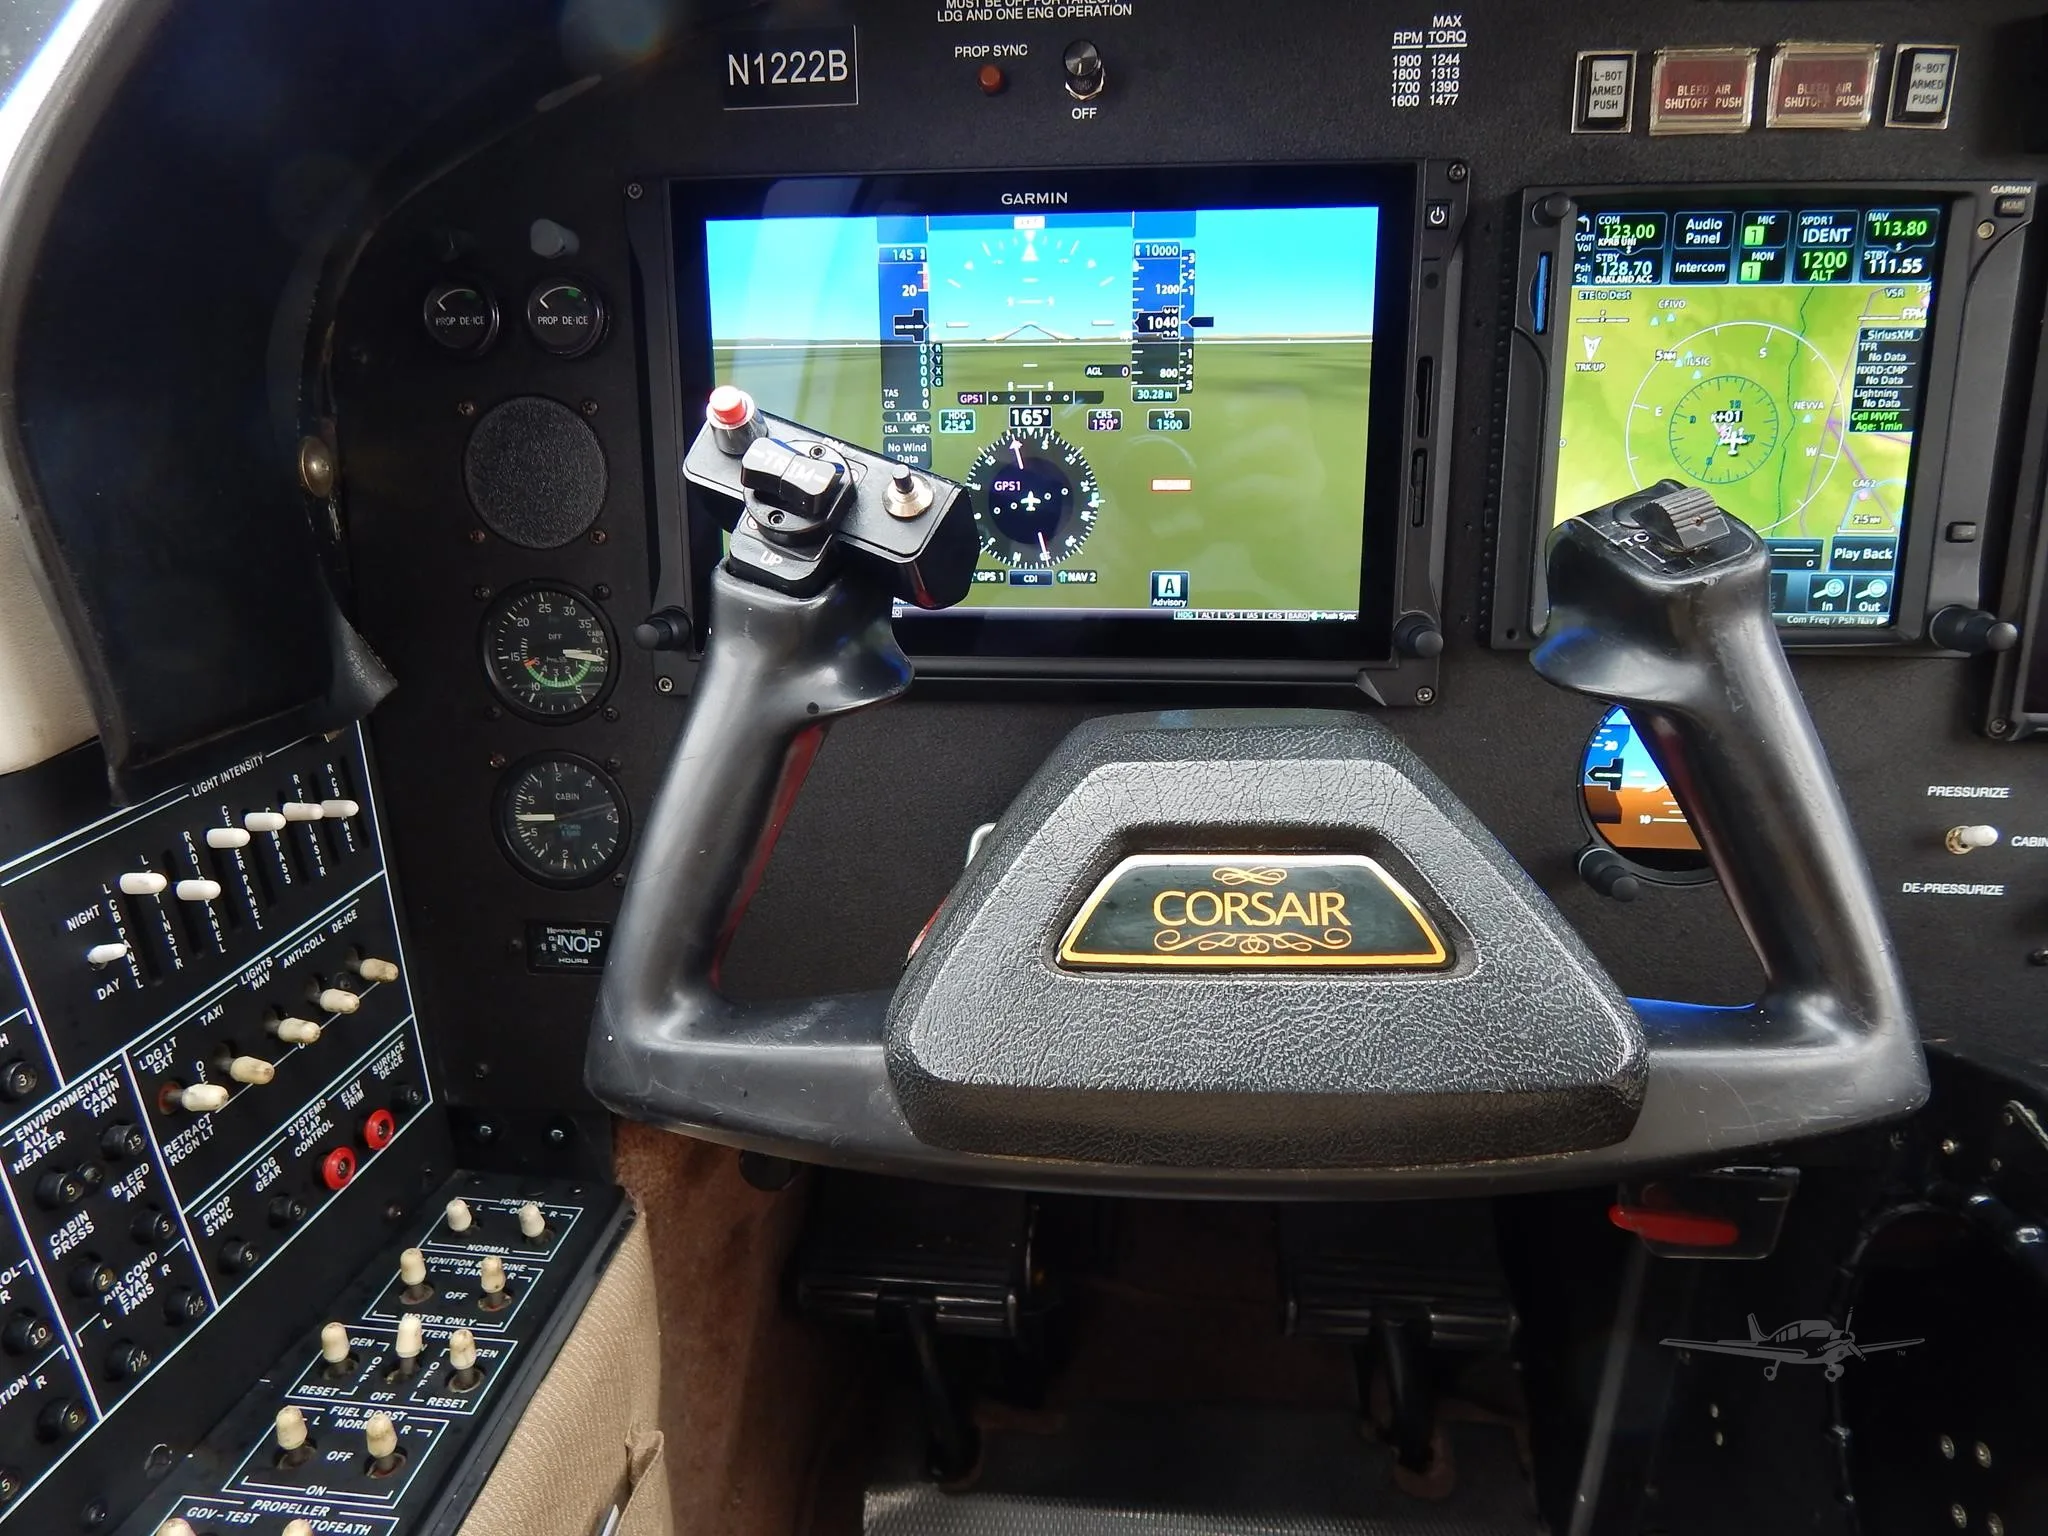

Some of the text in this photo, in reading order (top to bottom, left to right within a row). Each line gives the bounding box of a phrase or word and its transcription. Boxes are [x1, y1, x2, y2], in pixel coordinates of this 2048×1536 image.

[938, 4, 1132, 22] LDG AND ONE ENG OPERATION
[1432, 15, 1463, 28] MAX
[1393, 30, 1467, 45] RPM TORQ
[954, 43, 1029, 58] PROP SYNC
[1392, 53, 1461, 67] 1900 1244
[728, 48, 849, 87] N1222B
[1391, 67, 1460, 80] 1800 1313
[1914, 62, 1946, 74] R-BOT
[1593, 71, 1623, 81] L-BOT
[1391, 80, 1459, 94] 1700 1390
[1592, 85, 1623, 96] ARMED
[1714, 84, 1731, 95] AIR
[1911, 79, 1944, 90] ARMED
[1391, 93, 1459, 107] 1600 1477
[1593, 99, 1618, 110] PUSH
[1664, 96, 1743, 110] SHUTOFF PUSH
[1835, 94, 1864, 107] PUSH
[1911, 93, 1939, 104] PUSH
[1072, 107, 1098, 120] OFF
[1990, 185, 2032, 194] GARMIN
[1001, 191, 1068, 205] GARMIN
[1599, 215, 1620, 226] COM
[1757, 215, 1775, 225] MIC
[1801, 214, 1833, 226] XPDR1
[1868, 211, 1888, 222] NAV
[1685, 217, 1723, 231] Audio
[1872, 220, 1927, 237] 113.80
[1575, 232, 1596, 242] Com
[1604, 224, 1656, 240] 123.00
[1802, 227, 1851, 244] IDENT
[1685, 232, 1720, 247] Panel
[1144, 244, 1180, 257] 10000
[1577, 243, 1592, 253] Vol
[892, 249, 914, 261] 145
[1595, 253, 1620, 263] STBY
[1751, 251, 1774, 261] MON
[1801, 251, 1847, 269] 1200
[1864, 250, 1888, 260] STBY
[1574, 263, 1591, 274] Psh
[1600, 261, 1653, 276] 128.70
[1675, 261, 1726, 274] Intercom
[1869, 258, 1922, 274] 111.55
[1574, 274, 1588, 285] Sq
[1595, 274, 1653, 284] OAKLAND ACC
[1809, 269, 1834, 281] ALT
[902, 284, 918, 297] 20
[1156, 283, 1180, 295] 1200
[1578, 290, 1631, 300] ETE Dest
[1885, 288, 1905, 298] VSR
[538, 316, 559, 326] PROP
[1147, 315, 1179, 329] 1040
[1867, 329, 1914, 340] SiriusXM
[1859, 342, 1877, 352] TFR
[1869, 352, 1906, 362] No Data
[1086, 366, 1129, 377] AGL 0
[1159, 367, 1179, 379] 800
[1866, 376, 1904, 386] No Data
[883, 389, 899, 398] TAS
[960, 394, 983, 404] GPS1
[1854, 388, 1898, 401] Lightning
[883, 400, 896, 409] GS
[1862, 399, 1901, 409] No Data
[896, 412, 917, 422] 1.0G
[1011, 409, 1050, 425] 165°
[1092, 418, 1119, 430] 150°
[1157, 418, 1183, 430] 1500
[888, 442, 928, 453] No Wind
[994, 481, 1021, 492] GPS1
[1833, 546, 1893, 562] Play Back
[977, 572, 993, 582] GPS
[1023, 575, 1038, 583] CDI
[1067, 572, 1089, 582] NAV
[1152, 597, 1188, 608] Advisory
[1821, 601, 1834, 613] In
[1858, 601, 1881, 613] Out
[1786, 615, 1876, 626] Com Freq Psh Nav
[191, 754, 265, 798] LIGHT INTENSITY
[555, 792, 580, 801] CABIN
[1928, 784, 2009, 799] PRESSURIZE
[1902, 882, 2005, 896] DE-PRESSURIZE
[1153, 890, 1352, 928] CORSAIR
[66, 903, 101, 932] NIGHT
[251, 908, 359, 991] NAV ANTI-COLL DE-ICE
[557, 934, 601, 954] INOP
[240, 956, 274, 986] LIGHTS
[96, 977, 122, 1002] DAY
[200, 1004, 226, 1027] TAXI
[139, 1046, 160, 1071] LDG
[153, 1053, 174, 1075] EXT
[371, 1040, 406, 1075] SURFACE
[82, 1077, 121, 1112] CABIN
[339, 1079, 362, 1103] ELEV
[14, 1067, 116, 1143] ENVIRONMENTAL
[92, 1092, 118, 1119] FAN
[343, 1089, 366, 1112] TRIM
[287, 1097, 328, 1138] SYSTEMS
[299, 1114, 322, 1140] FLAP
[23, 1126, 51, 1155] AUX
[162, 1112, 212, 1158] RETRACT
[294, 1118, 335, 1158] CONTROL
[12, 1129, 67, 1176] HEATER
[169, 1137, 199, 1167] RCGN
[255, 1155, 277, 1180] LDG
[111, 1161, 151, 1200] BLEED
[255, 1164, 283, 1194] GEAR
[126, 1180, 147, 1203] AIR
[499, 1197, 545, 1209] IGNITION
[201, 1195, 232, 1226] PROP
[206, 1206, 235, 1238] SYNC
[49, 1209, 91, 1249] CABIN
[52, 1220, 96, 1261] PRESS
[466, 1243, 510, 1256] NORMAL
[125, 1250, 159, 1287] COND
[427, 1255, 473, 1269] IGNITION
[118, 1271, 151, 1306] EVAP
[121, 1282, 156, 1317] FANS
[445, 1291, 468, 1301] OFF
[445, 1315, 477, 1328] ONLY
[349, 1336, 376, 1349] GEN
[298, 1384, 469, 1410] RESET OFF RESET
[329, 1405, 361, 1419] FUEL
[327, 1450, 355, 1463] OFF
[305, 1485, 327, 1497] ON
[250, 1499, 331, 1518] PROPELLER
[186, 1505, 261, 1526] GOV-TEST
